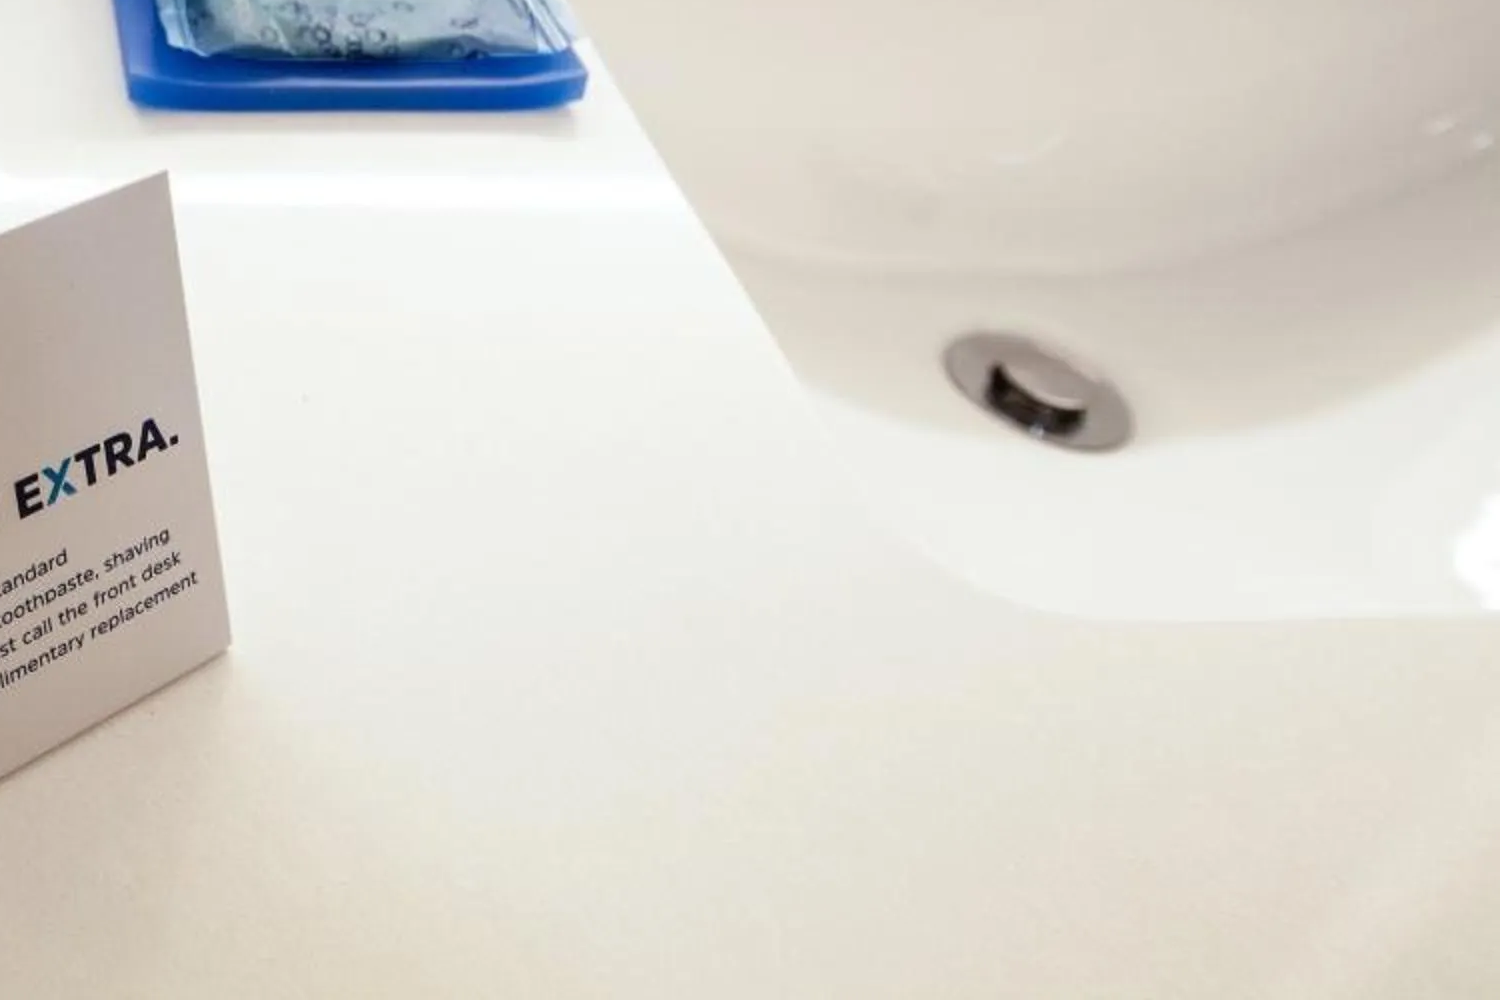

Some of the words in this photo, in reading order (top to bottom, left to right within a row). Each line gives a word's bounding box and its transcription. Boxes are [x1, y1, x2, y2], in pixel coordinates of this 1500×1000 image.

[12, 417, 180, 521] EXTRA.
[102, 528, 171, 574] shaving
[21, 616, 53, 646] call
[57, 601, 89, 627] the
[92, 573, 137, 609] front
[140, 551, 182, 583] desk
[89, 570, 199, 640] replacement
